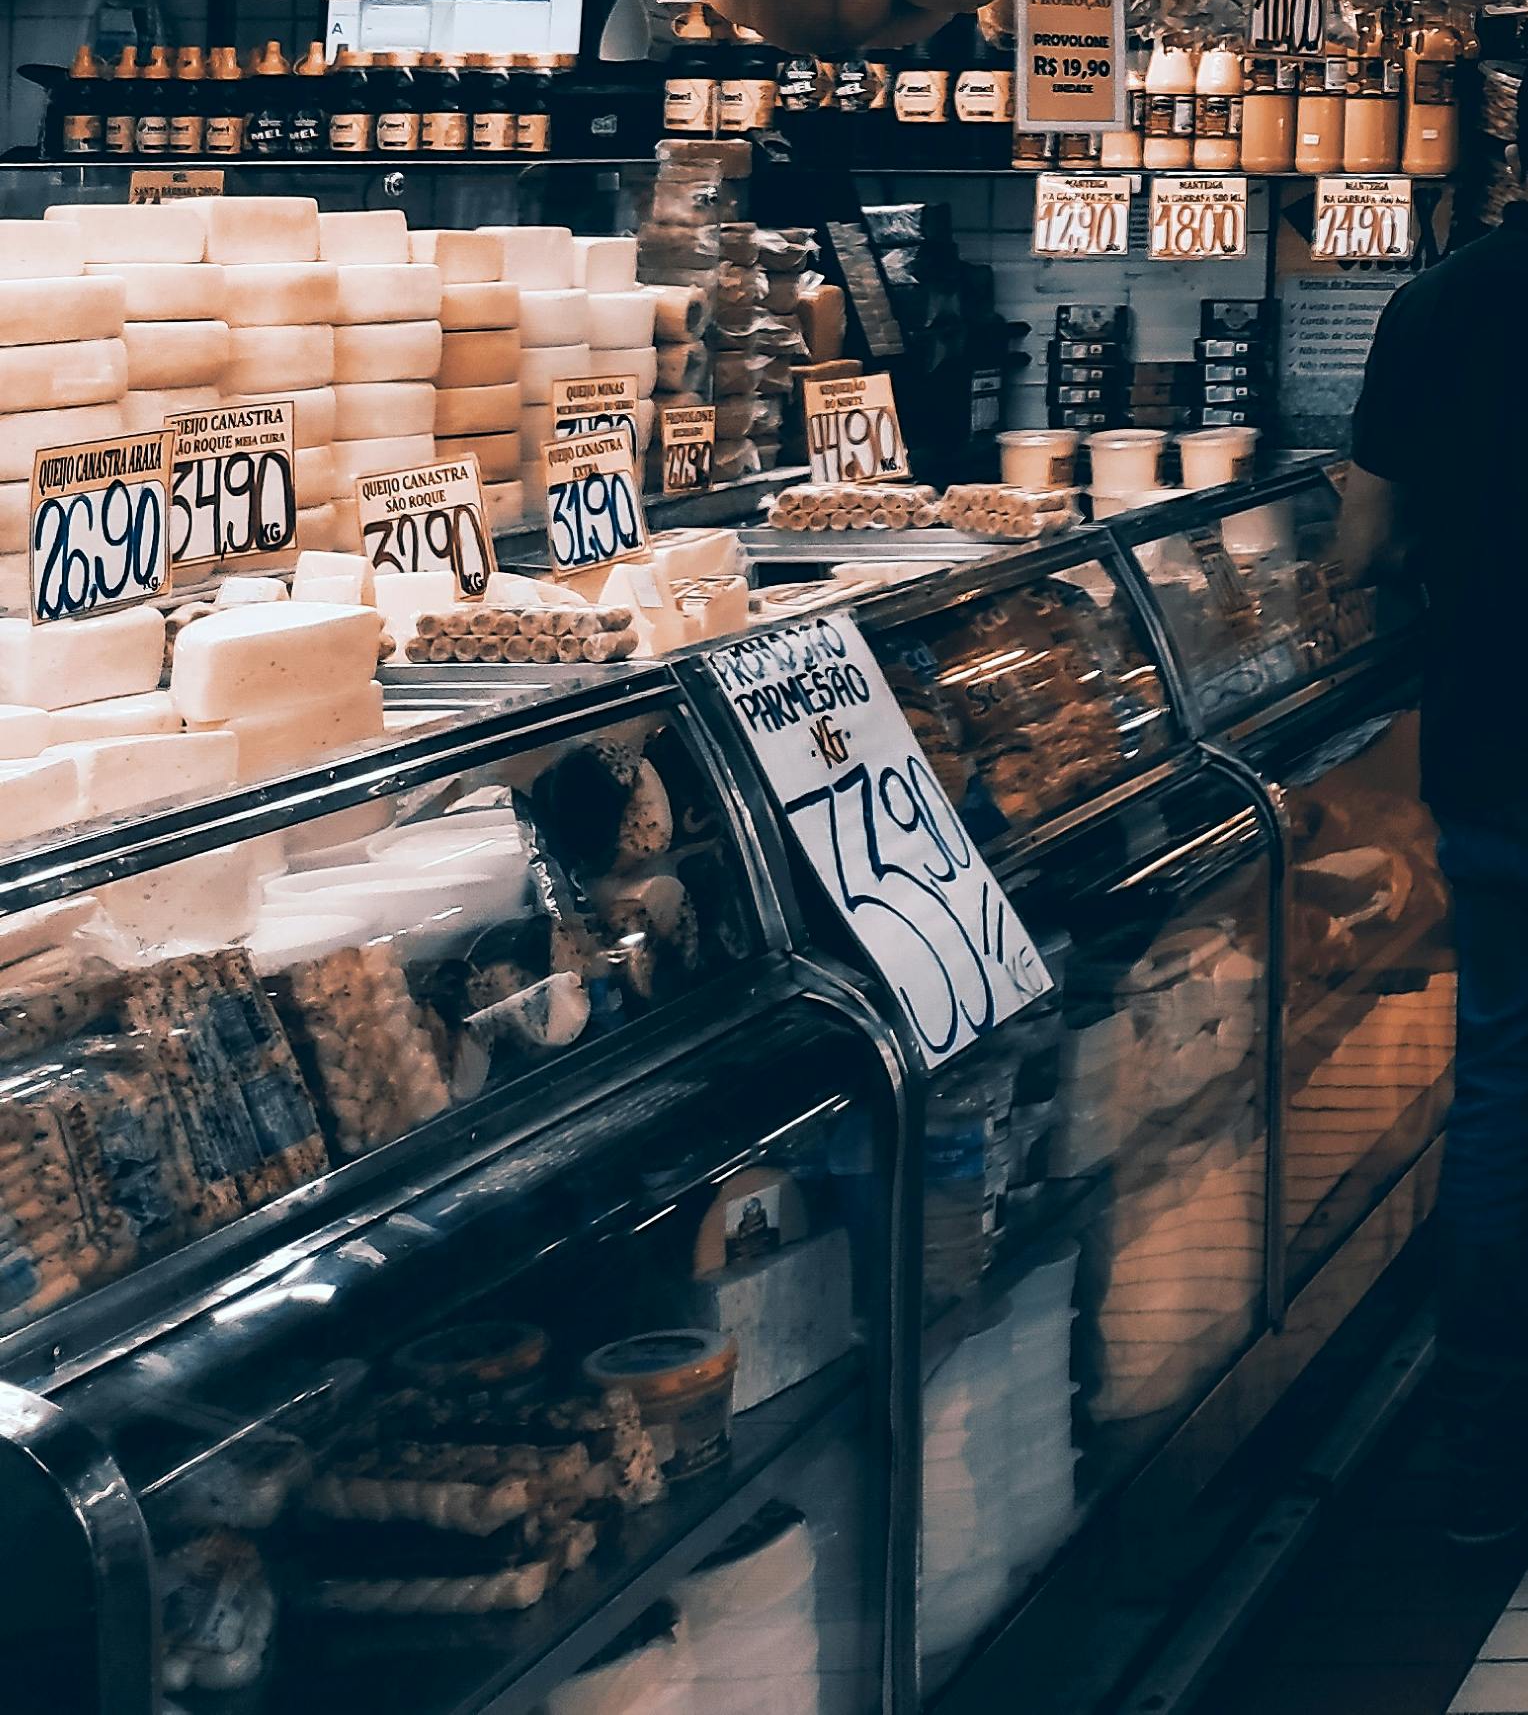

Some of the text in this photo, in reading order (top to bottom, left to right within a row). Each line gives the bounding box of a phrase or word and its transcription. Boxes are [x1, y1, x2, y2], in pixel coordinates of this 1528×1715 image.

[1034, 34, 1110, 48] PROVOLONE
[1033, 55, 1110, 79] R$ 19,90
[566, 382, 625, 401] QUEIJO MINAS
[211, 408, 284, 431] CANASTRA
[176, 438, 191, 456] ÃO
[194, 435, 232, 453] ROQUE
[549, 438, 624, 468] QUEIJO CANASTRA
[39, 435, 162, 495] QUEIJO CANASTRA ARAXÁ
[362, 466, 469, 501] QUEIJO CANASTRA
[385, 490, 446, 513] SÃO ROQUE
[734, 664, 871, 733] PARMESÃO
